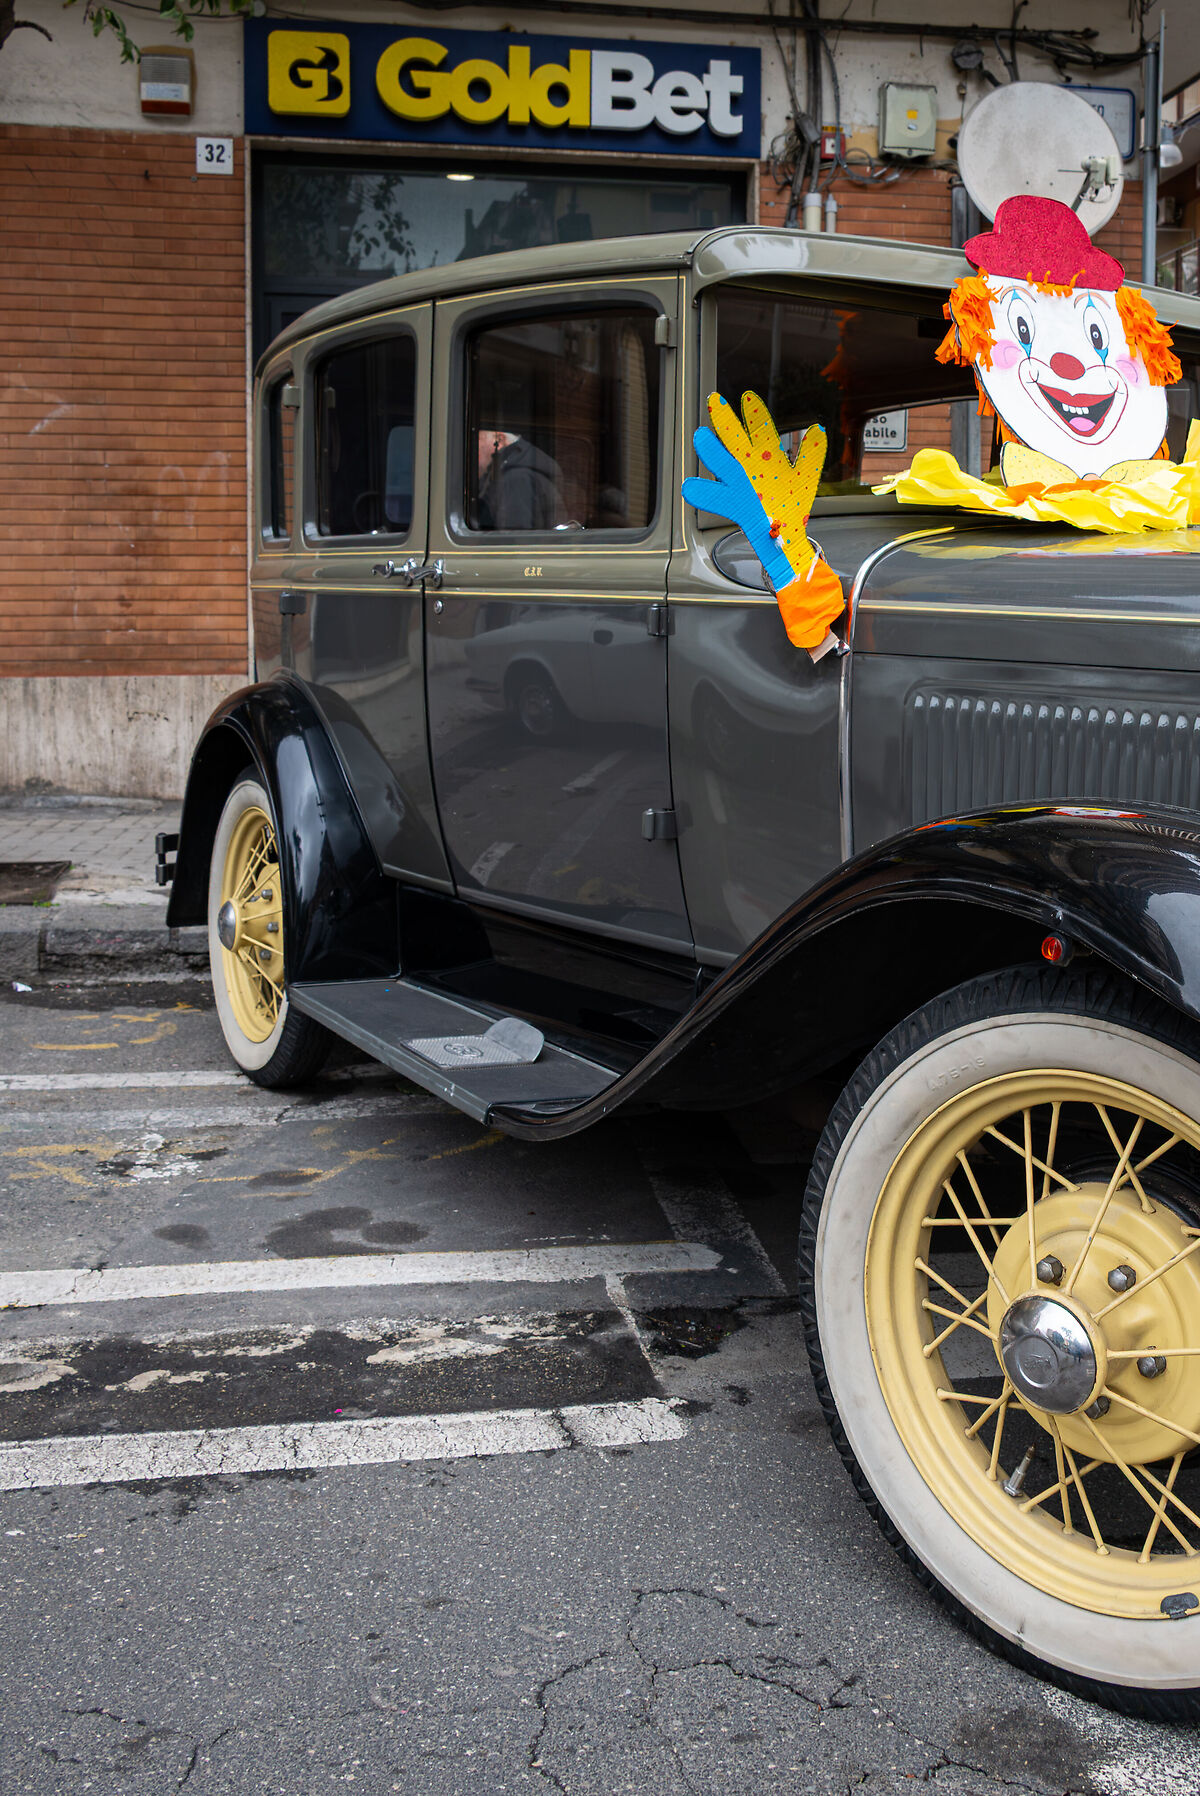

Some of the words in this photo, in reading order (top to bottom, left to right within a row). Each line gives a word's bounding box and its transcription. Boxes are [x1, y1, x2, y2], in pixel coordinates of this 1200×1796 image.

[375, 37, 744, 137] GoldBet
[205, 144, 225, 163] 32
[865, 427, 897, 438] abile
